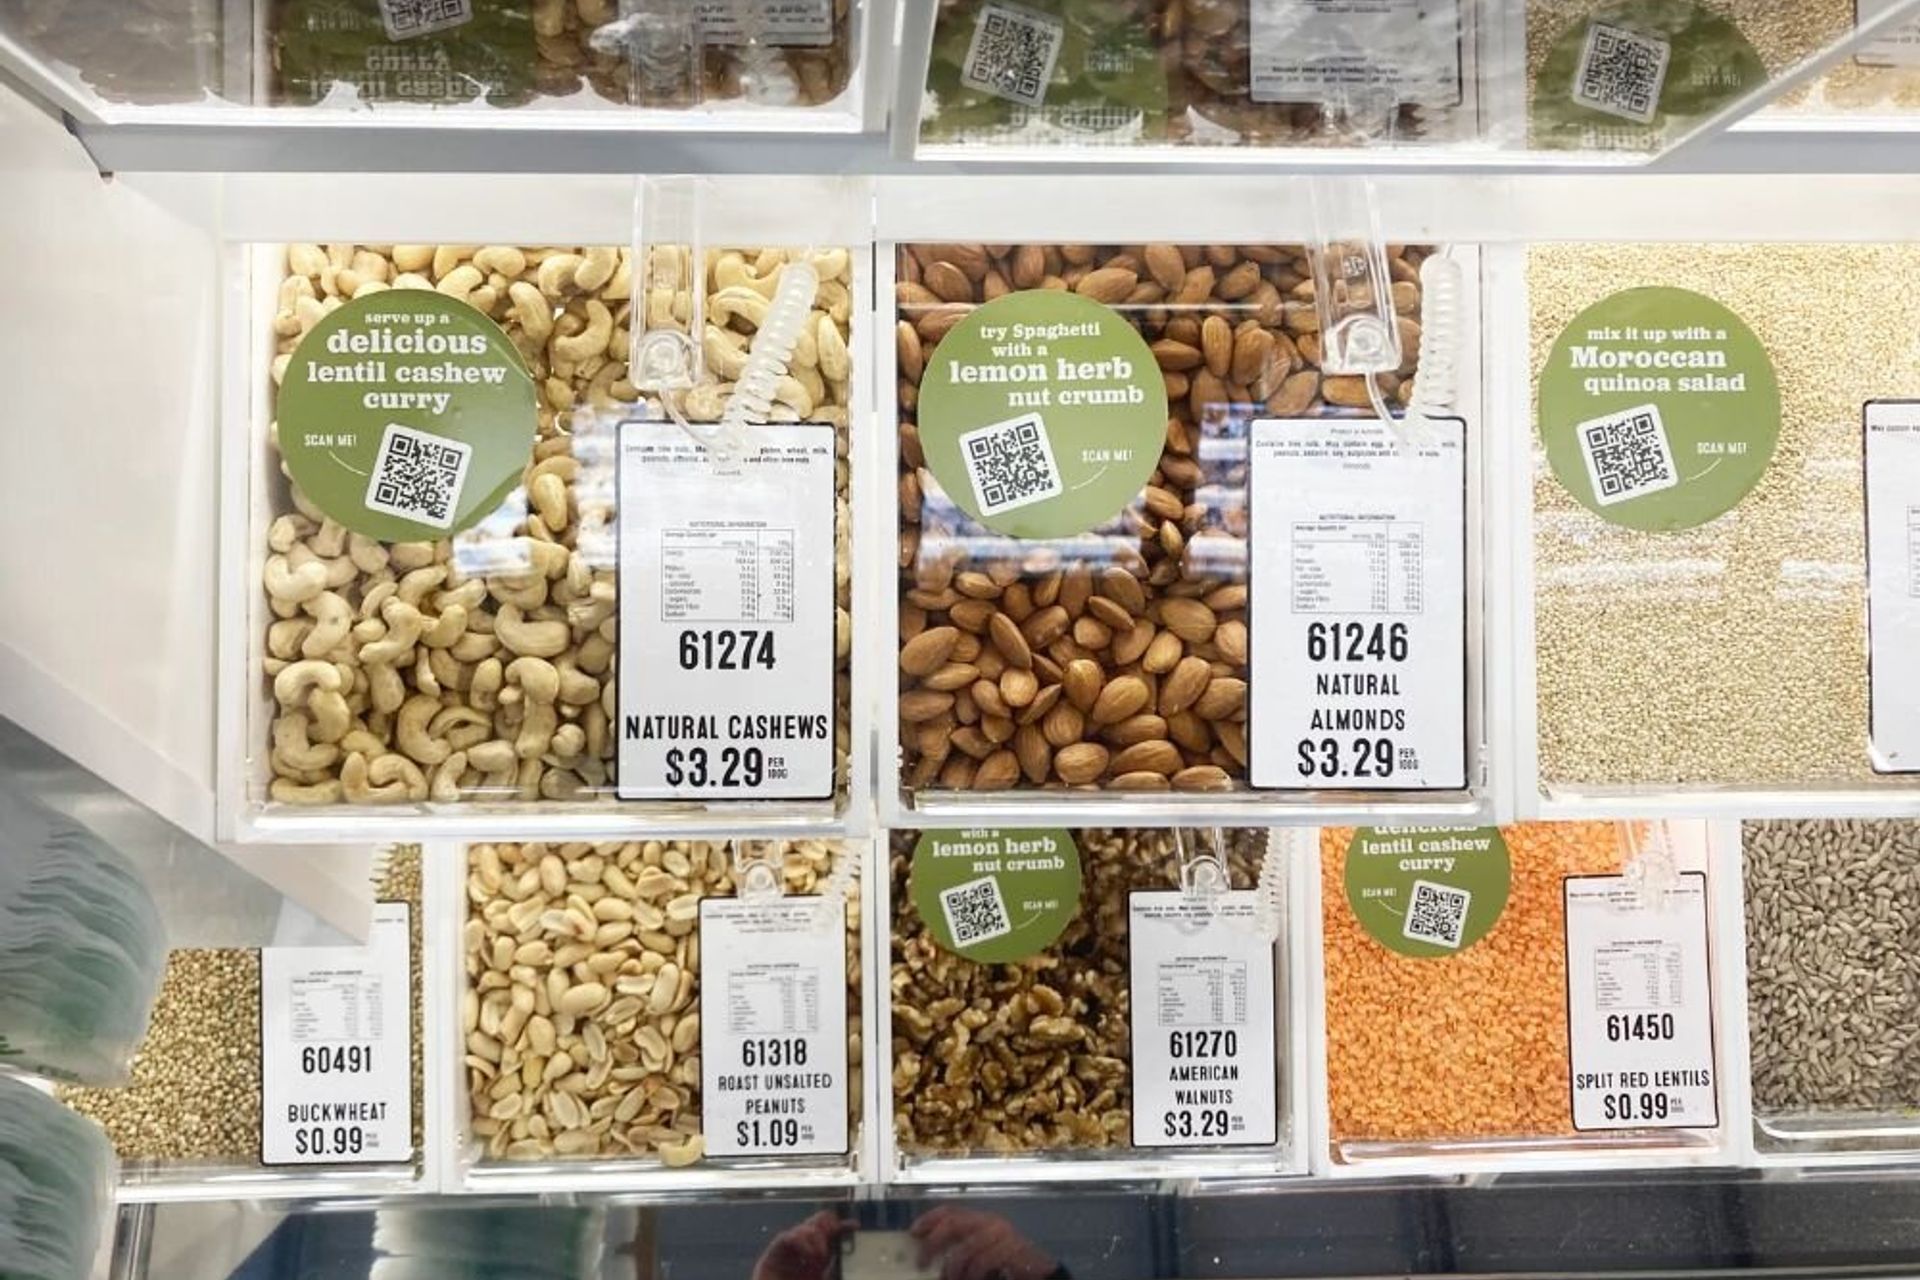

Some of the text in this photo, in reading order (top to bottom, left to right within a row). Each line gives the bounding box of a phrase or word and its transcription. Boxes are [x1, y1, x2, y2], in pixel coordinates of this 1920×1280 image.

[365, 313, 450, 326] serve up a
[327, 329, 488, 354] delicious
[980, 322, 1101, 340] try Spaghetti
[1587, 327, 1727, 342] mix it up with a
[992, 343, 1048, 357] with a
[1569, 346, 1727, 368] Moroccan
[307, 361, 507, 383] lentil cashew
[950, 356, 1133, 384] lemon herb
[1584, 373, 1746, 395] quinoa salad
[363, 392, 451, 414] curry
[1008, 385, 1145, 407] nut crumb
[305, 434, 357, 446] SCAN ME!
[1697, 442, 1747, 454] SCAN ME!
[1082, 449, 1133, 462] SCAN ME!
[679, 630, 776, 670] 61274
[1307, 622, 1408, 661] 61246
[1317, 674, 1400, 695] NATURAL
[626, 715, 828, 740] NATURAL CASHEWS
[1310, 709, 1406, 730] ALMONDS
[768, 757, 784, 767] PER
[1298, 737, 1394, 778] $3.29
[1399, 747, 1415, 758] PER
[666, 746, 763, 788] $3.29
[960, 829, 988, 839] with
[932, 836, 1057, 857] lemon herb
[1362, 837, 1491, 855] lentil cashew
[973, 856, 1065, 872] nut crumb
[1398, 857, 1456, 873] curry
[1607, 1013, 1675, 1042] 61450
[742, 1038, 808, 1067] 61318
[1170, 1030, 1237, 1058] 61270
[302, 1046, 372, 1074] 60491
[718, 1073, 833, 1091] ROAST UNSALTED
[1169, 1066, 1239, 1081] AMERICAN
[1576, 1069, 1710, 1090] SPLIT RED LENTILS
[745, 1098, 806, 1114] PEANUTS
[1175, 1089, 1233, 1105] WALNUTS
[1605, 1093, 1668, 1120] $0.99
[288, 1102, 387, 1123] BUCKWHEAT
[1164, 1109, 1229, 1137] $3.29
[295, 1126, 363, 1154] $0.99
[737, 1119, 799, 1147] $1.09
